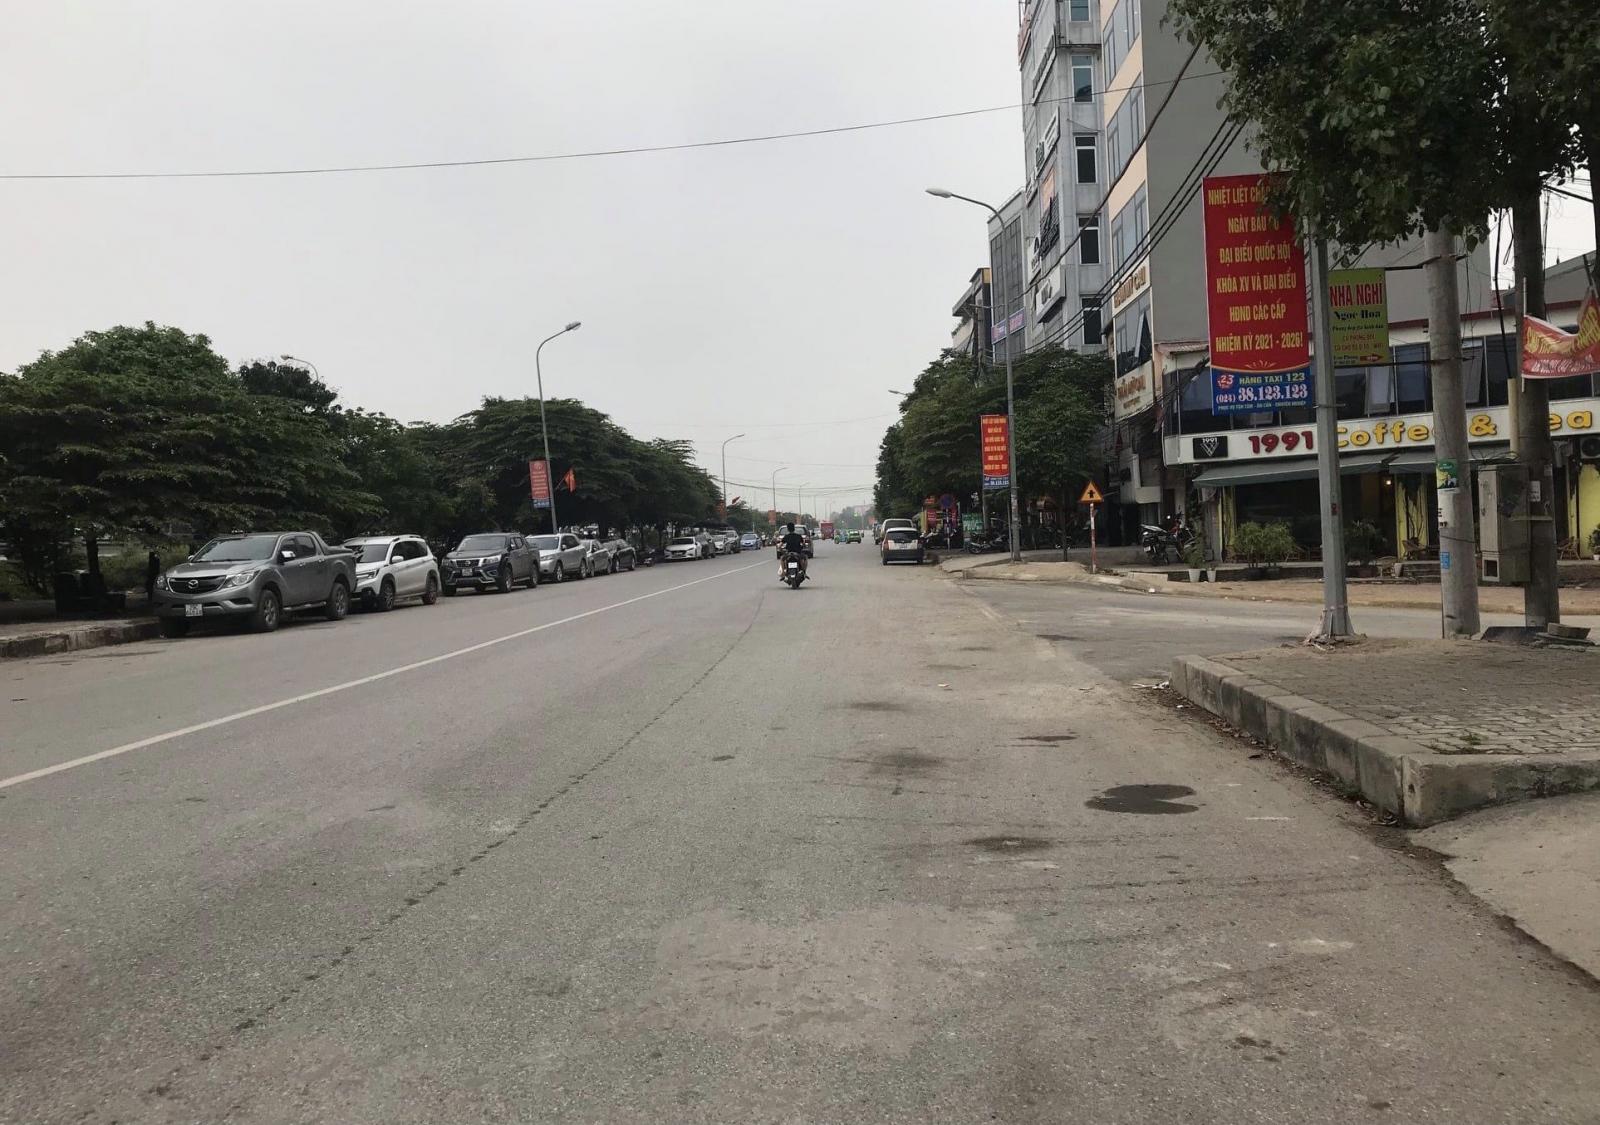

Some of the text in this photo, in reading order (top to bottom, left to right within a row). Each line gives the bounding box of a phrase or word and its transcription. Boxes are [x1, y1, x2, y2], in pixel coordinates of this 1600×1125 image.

[1208, 185, 1231, 208] NHIỆT
[1232, 184, 1249, 207] LIỆT
[1227, 213, 1250, 233] NGÀY
[1220, 240, 1291, 267] ĐẠI BIỂU QUỐC HỘI
[1239, 275, 1250, 292] XV
[1251, 272, 1262, 291] VÀ
[1263, 274, 1277, 294] ĐẠI
[1278, 266, 1297, 289] BIỂU
[1252, 300, 1269, 321] CÁC
[1270, 298, 1286, 320] CẤP
[1215, 332, 1241, 355] NHIỆM
[1255, 333, 1273, 350] 2021
[1281, 331, 1303, 349] 2026!
[1264, 375, 1282, 384] TAXI
[1285, 372, 1305, 382] 123
[1238, 383, 1308, 402] 38.123.123
[1249, 410, 1593, 455] 1991 Coffe & ea
